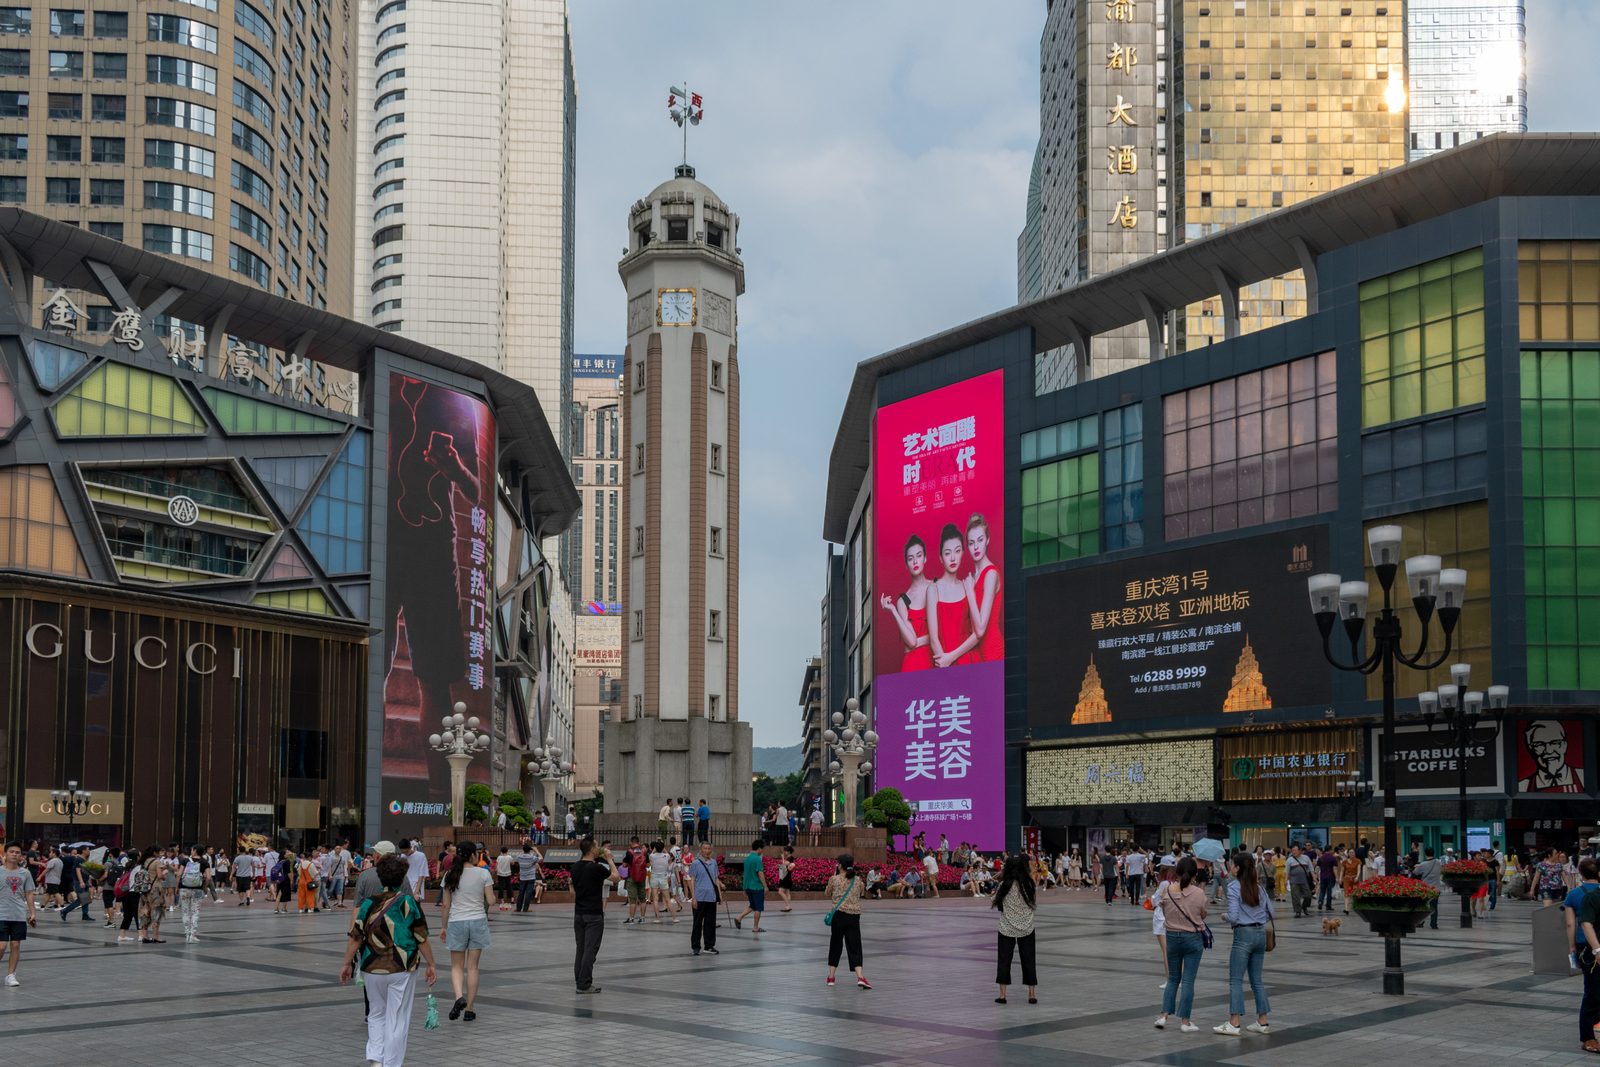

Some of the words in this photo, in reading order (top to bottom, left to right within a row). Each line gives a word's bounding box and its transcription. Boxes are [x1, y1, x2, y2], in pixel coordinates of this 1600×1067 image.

[902, 415, 976, 456] 艺术面雕
[468, 505, 486, 691] 畅享热门赛事
[1125, 569, 1209, 602] 重庆湾1号
[1090, 601, 1170, 630] 喜来登双塔
[1179, 590, 1250, 618] 亚洲地标
[26, 622, 241, 679] GUCCI
[1176, 665, 1207, 680] 9999
[905, 695, 972, 739] 华美
[905, 739, 972, 781] 美容
[1259, 753, 1346, 769] 中国农业银行
[1408, 760, 1467, 772] COFFE
[403, 801, 444, 815] 腾讯新闻
